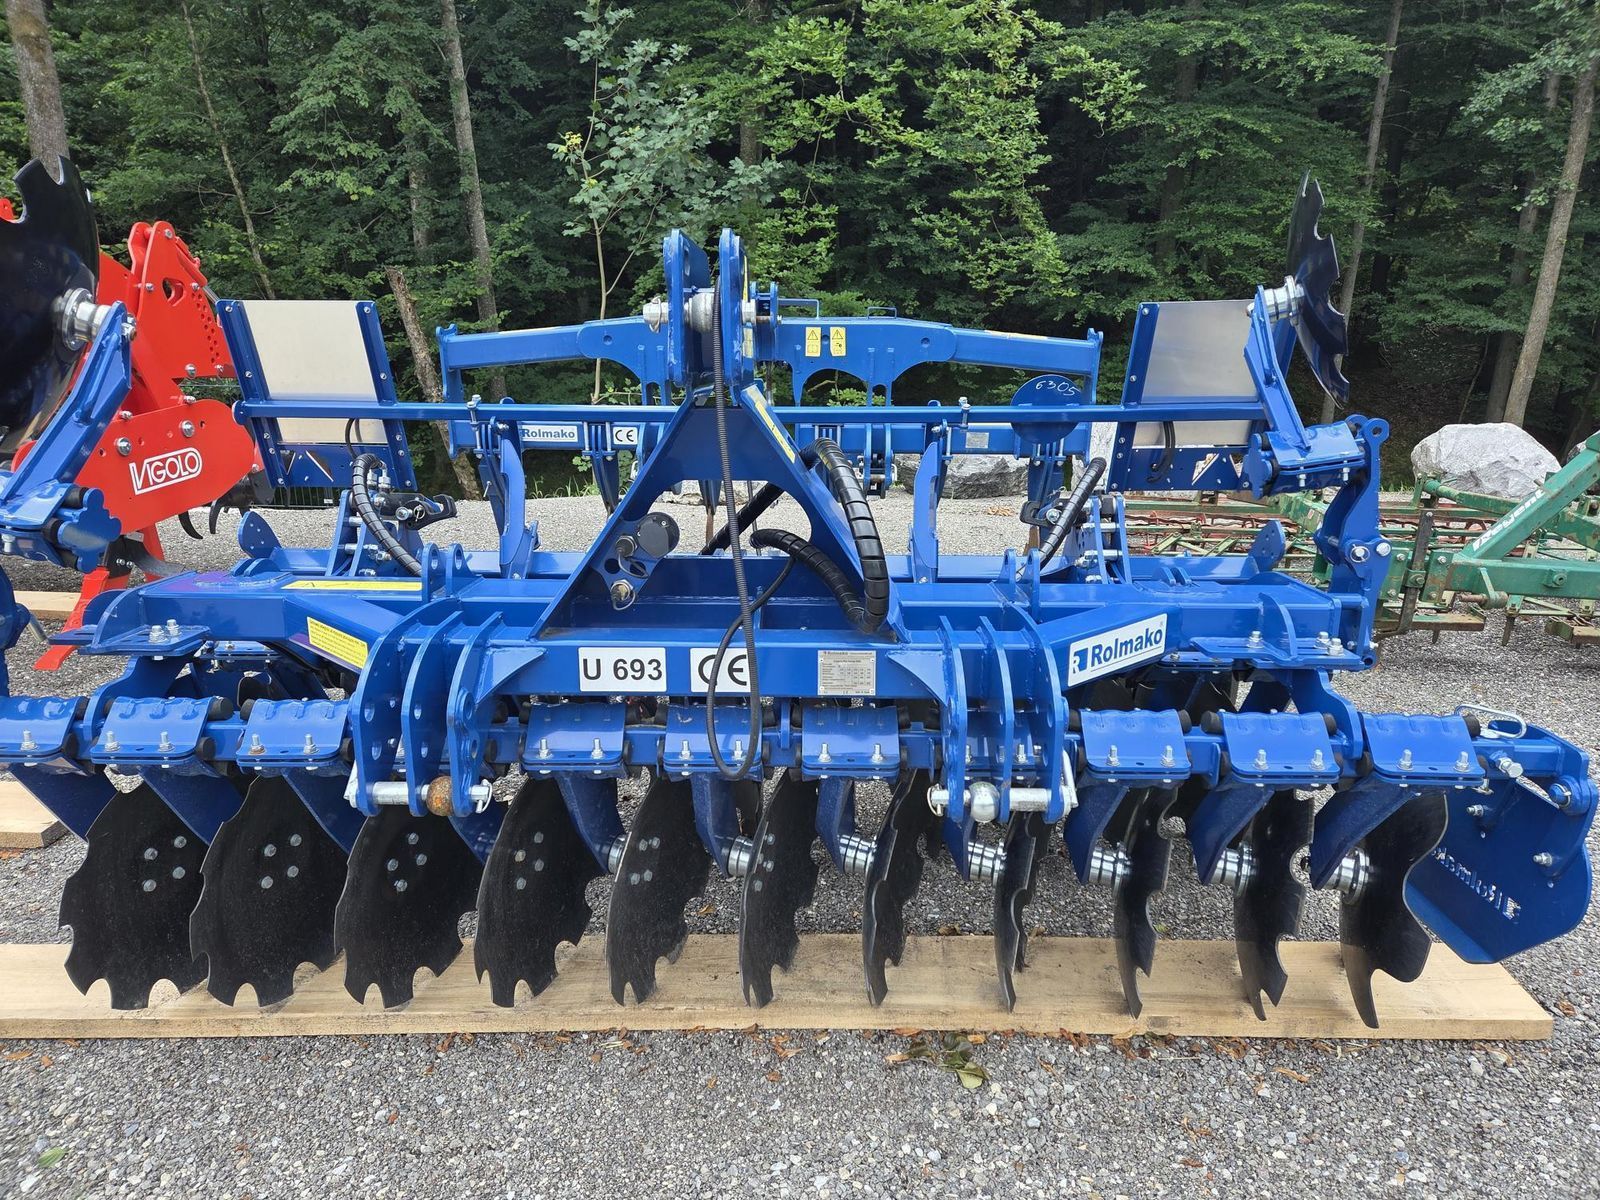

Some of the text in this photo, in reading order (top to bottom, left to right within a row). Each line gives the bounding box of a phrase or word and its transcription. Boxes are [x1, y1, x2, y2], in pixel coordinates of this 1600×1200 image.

[1035, 380, 1076, 396] 6305
[522, 429, 575, 438] Rolmako
[129, 451, 199, 495] VIGOLO
[1091, 628, 1162, 667] Rolmako
[582, 658, 662, 681] U 693
[698, 654, 747, 686] CE
